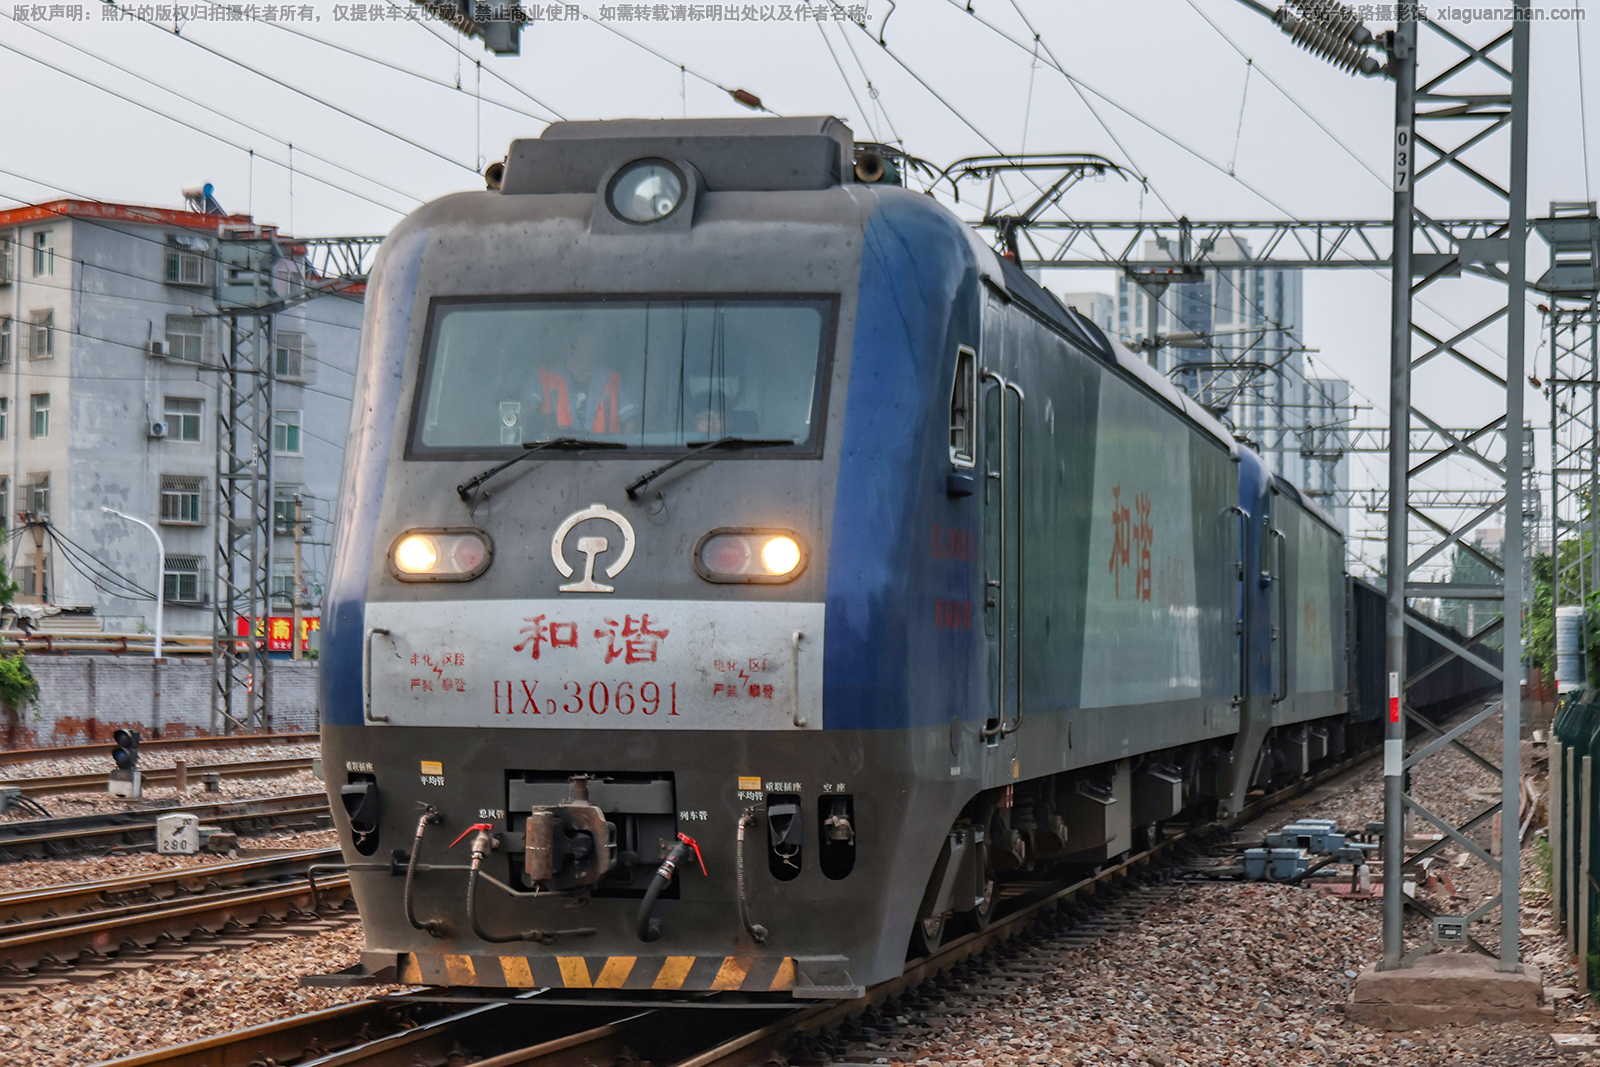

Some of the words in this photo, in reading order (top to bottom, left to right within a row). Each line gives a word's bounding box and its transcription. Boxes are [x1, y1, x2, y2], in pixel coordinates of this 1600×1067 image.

[1398, 132, 1407, 186] 037
[1109, 482, 1153, 603] 和谐
[513, 614, 669, 664] 和谐
[420, 775, 445, 786] 平均管
[737, 791, 763, 801] 平均管
[478, 809, 505, 819] 总风管
[680, 811, 707, 821] 列车管
[164, 840, 187, 850] 290
